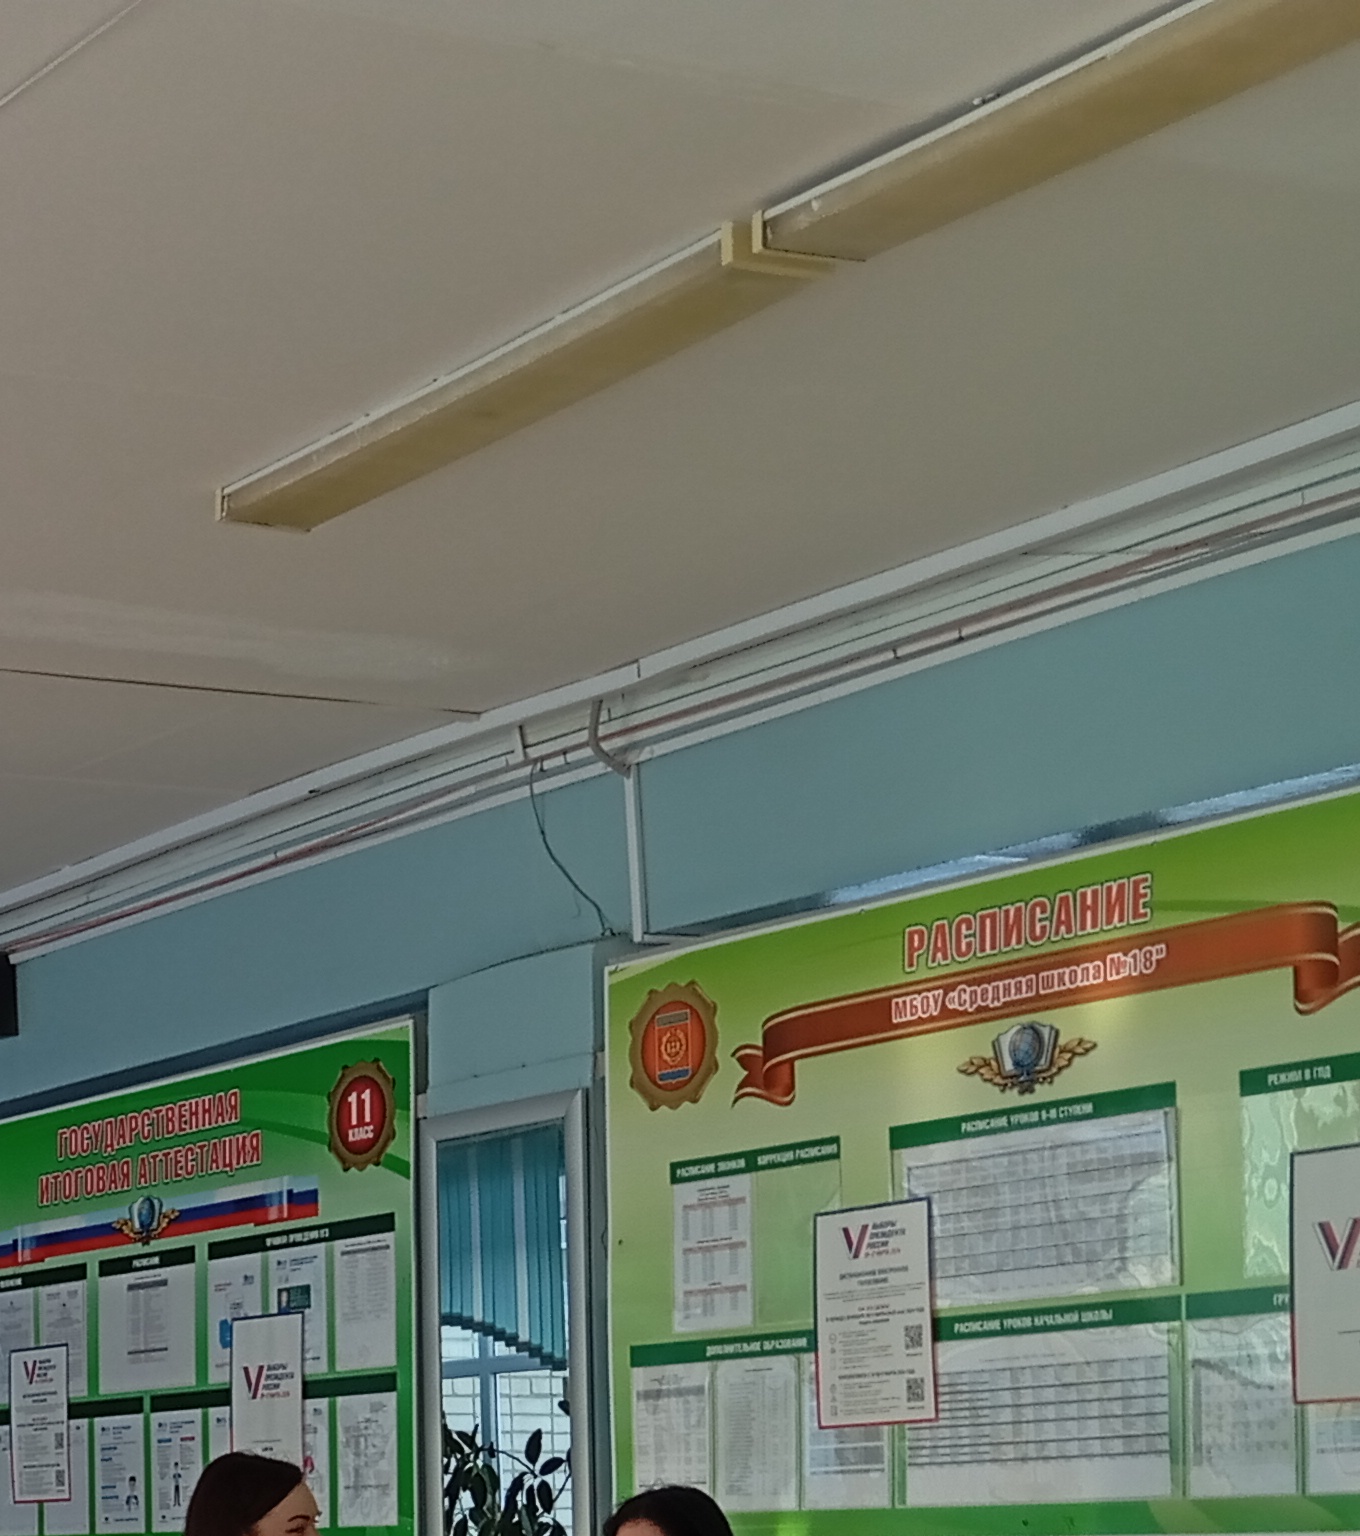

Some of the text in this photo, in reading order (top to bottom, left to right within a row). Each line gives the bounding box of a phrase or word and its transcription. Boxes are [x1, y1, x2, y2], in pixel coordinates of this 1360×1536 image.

[904, 873, 1153, 972] РАСПИСАНИЕ
[891, 990, 944, 1023] МБОУ
[945, 973, 1036, 1012] «Средняя
[1038, 959, 1104, 993] школа
[1267, 1070, 1302, 1086] РЕЖИМ
[56, 1088, 241, 1160] ГОСУДАРСТВЕННАЯ
[347, 1088, 372, 1126] 11
[960, 1115, 1009, 1134] РАСПИСАНИЕ
[348, 1125, 374, 1142] КЛАСС
[38, 1129, 263, 1207] ИТОГОВАЯ АТТЕСТАЦИЯ
[954, 1318, 1002, 1334] РАСПИСАНИЕ
